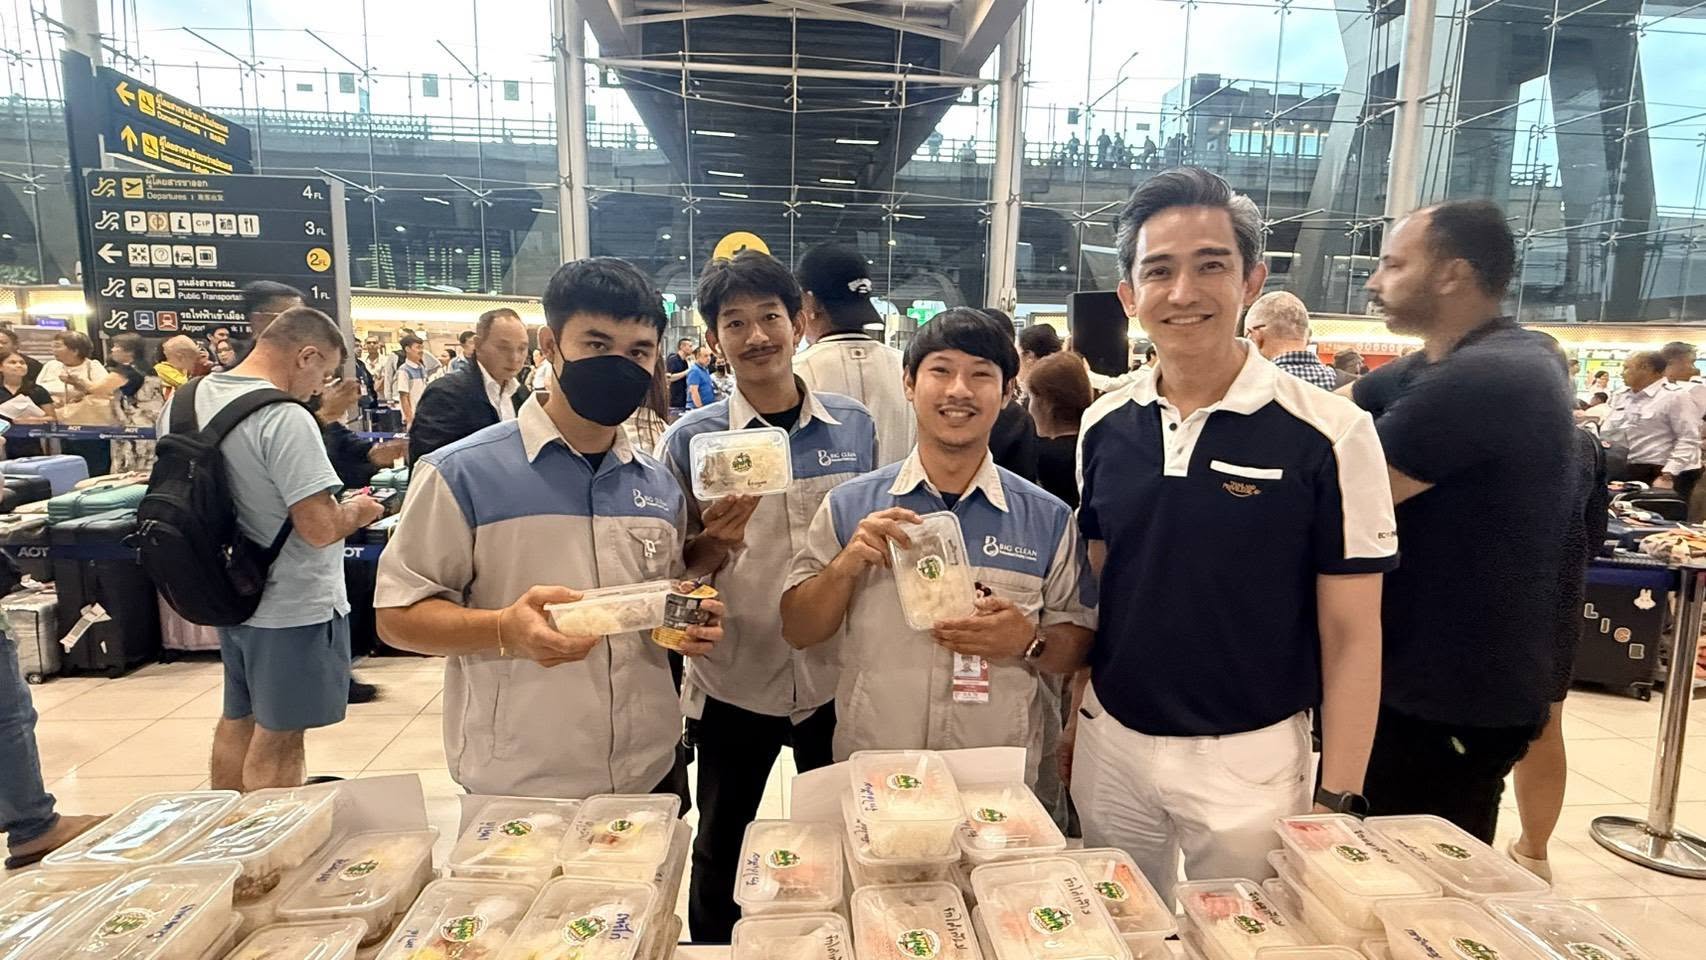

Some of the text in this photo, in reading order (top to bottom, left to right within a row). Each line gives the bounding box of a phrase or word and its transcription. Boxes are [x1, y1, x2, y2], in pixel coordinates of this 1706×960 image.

[146, 192, 187, 201] Departures
[178, 292, 201, 300] Public
[17, 546, 50, 558] AOT
[343, 546, 365, 558] OT
[1000, 543, 1013, 552] BIG
[1014, 546, 1038, 557] CLEAN
